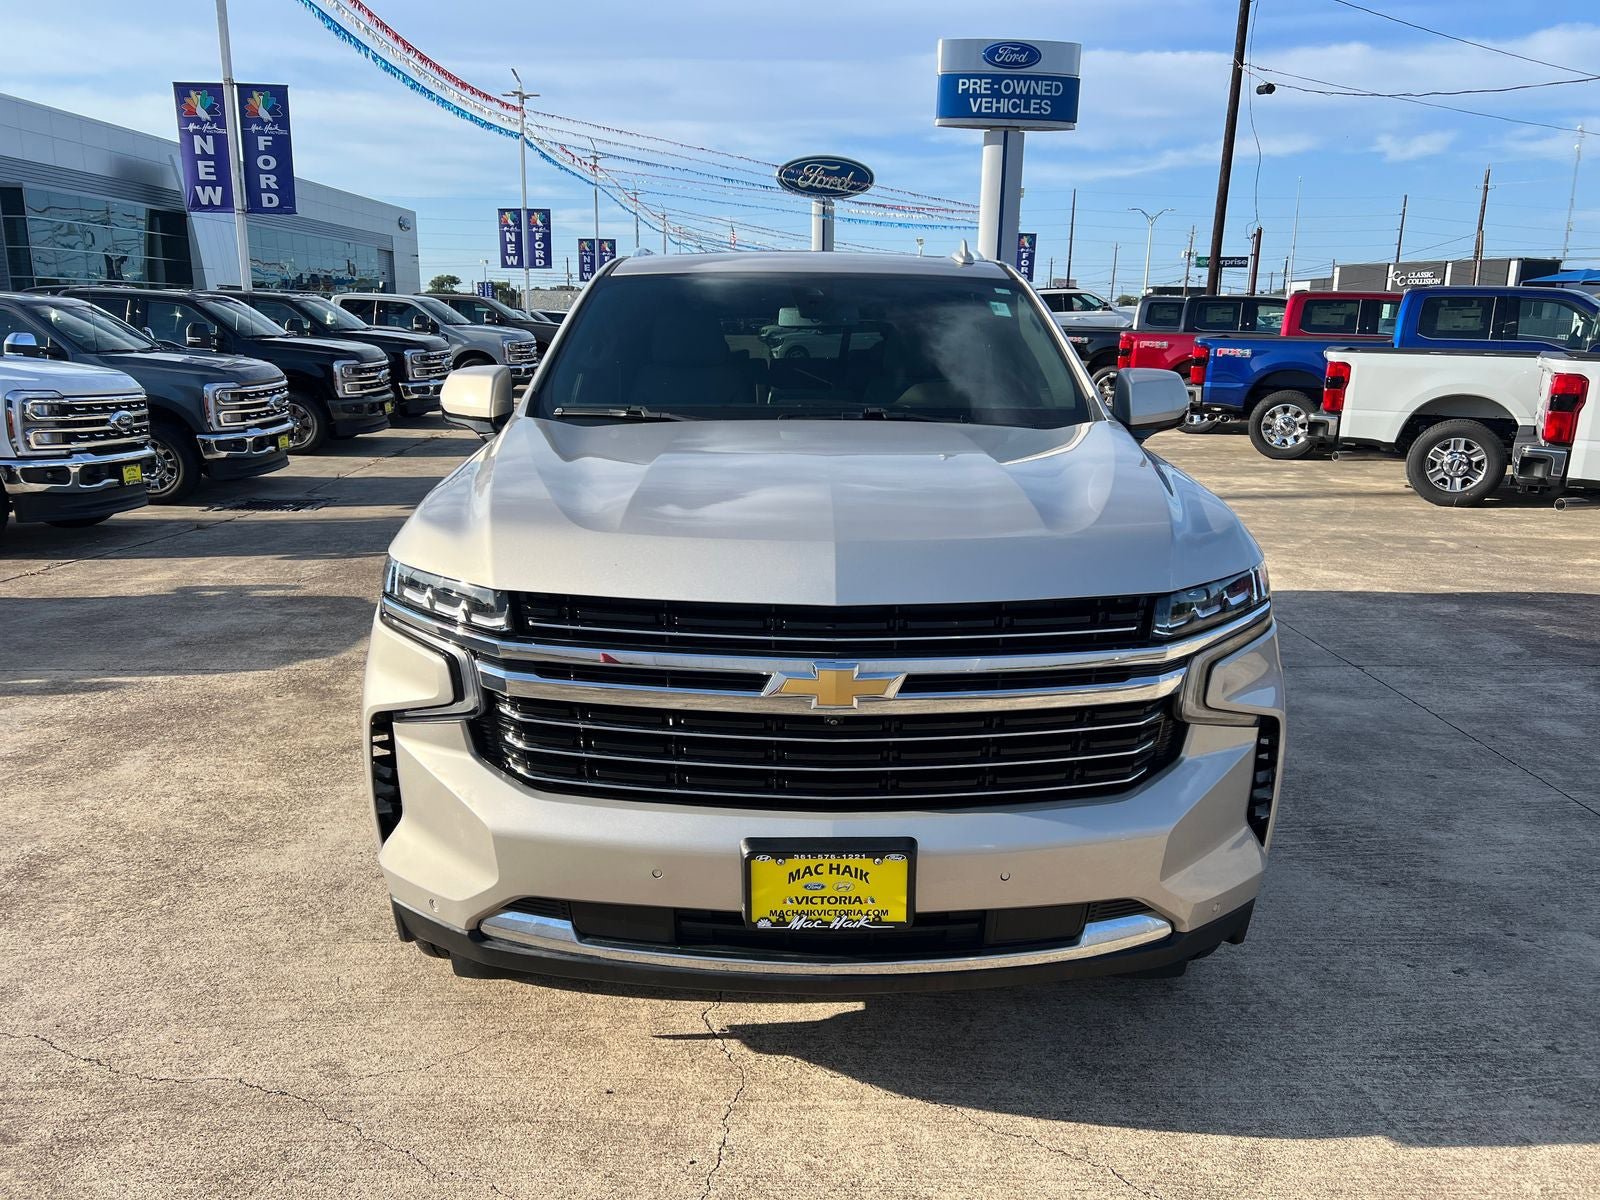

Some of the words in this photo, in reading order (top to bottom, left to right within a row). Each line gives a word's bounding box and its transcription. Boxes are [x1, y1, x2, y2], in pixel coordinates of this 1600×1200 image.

[994, 45, 1029, 62] Ford
[958, 78, 1063, 96] PRE-OWNED
[969, 97, 1051, 115] VEHICLES
[193, 135, 223, 206] NEW
[256, 135, 280, 208] FORD
[797, 163, 854, 190] Ford
[505, 232, 518, 266] NEW
[534, 232, 545, 267] FORD
[1408, 271, 1434, 279] CLASSIC
[787, 863, 824, 885] MAC
[828, 863, 870, 885] HAIK
[794, 895, 863, 905] VICTORIA
[769, 909, 889, 917] MACHAIKVICTORIA.COM
[787, 915, 828, 930] Mac
[830, 914, 874, 930] Haik
